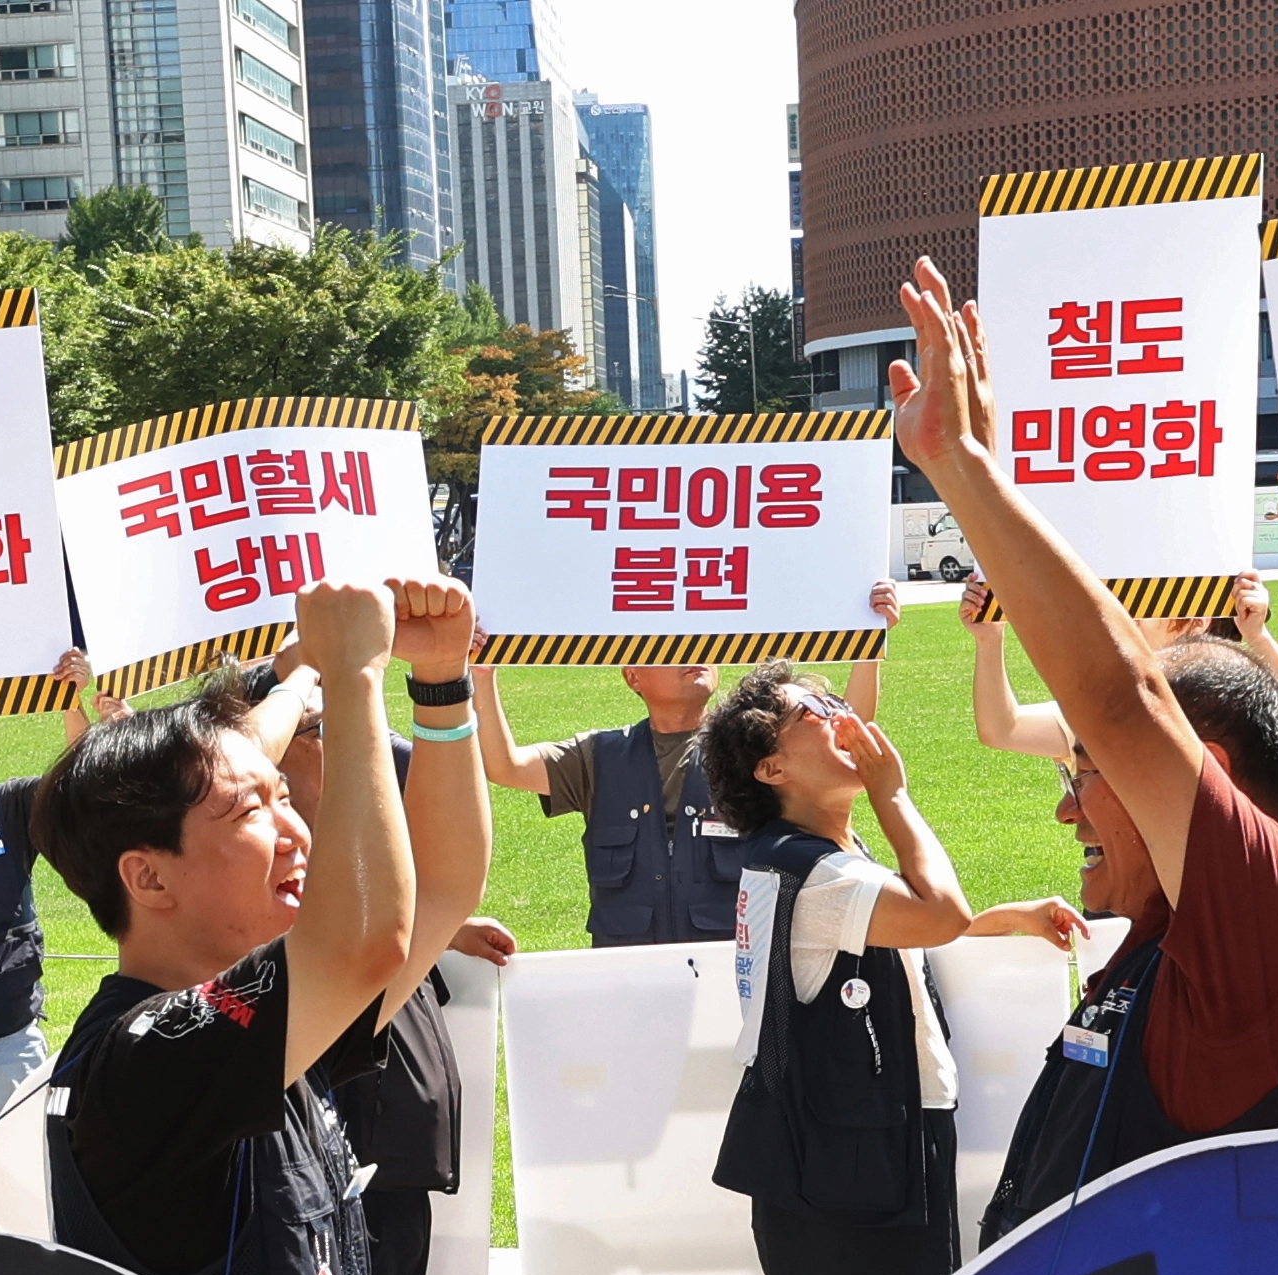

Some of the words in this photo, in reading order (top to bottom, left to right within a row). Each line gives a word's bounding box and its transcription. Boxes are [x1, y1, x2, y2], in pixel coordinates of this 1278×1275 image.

[465, 84, 502, 100] KYO
[470, 101, 514, 118] WON
[520, 100, 545, 115] 교원
[1048, 297, 1185, 380] 철도
[1011, 400, 1223, 485] 민영화
[117, 449, 378, 539] 국민혈세
[545, 462, 824, 531] 국민이용
[194, 531, 325, 613] 낭비
[611, 545, 750, 612] 불편
